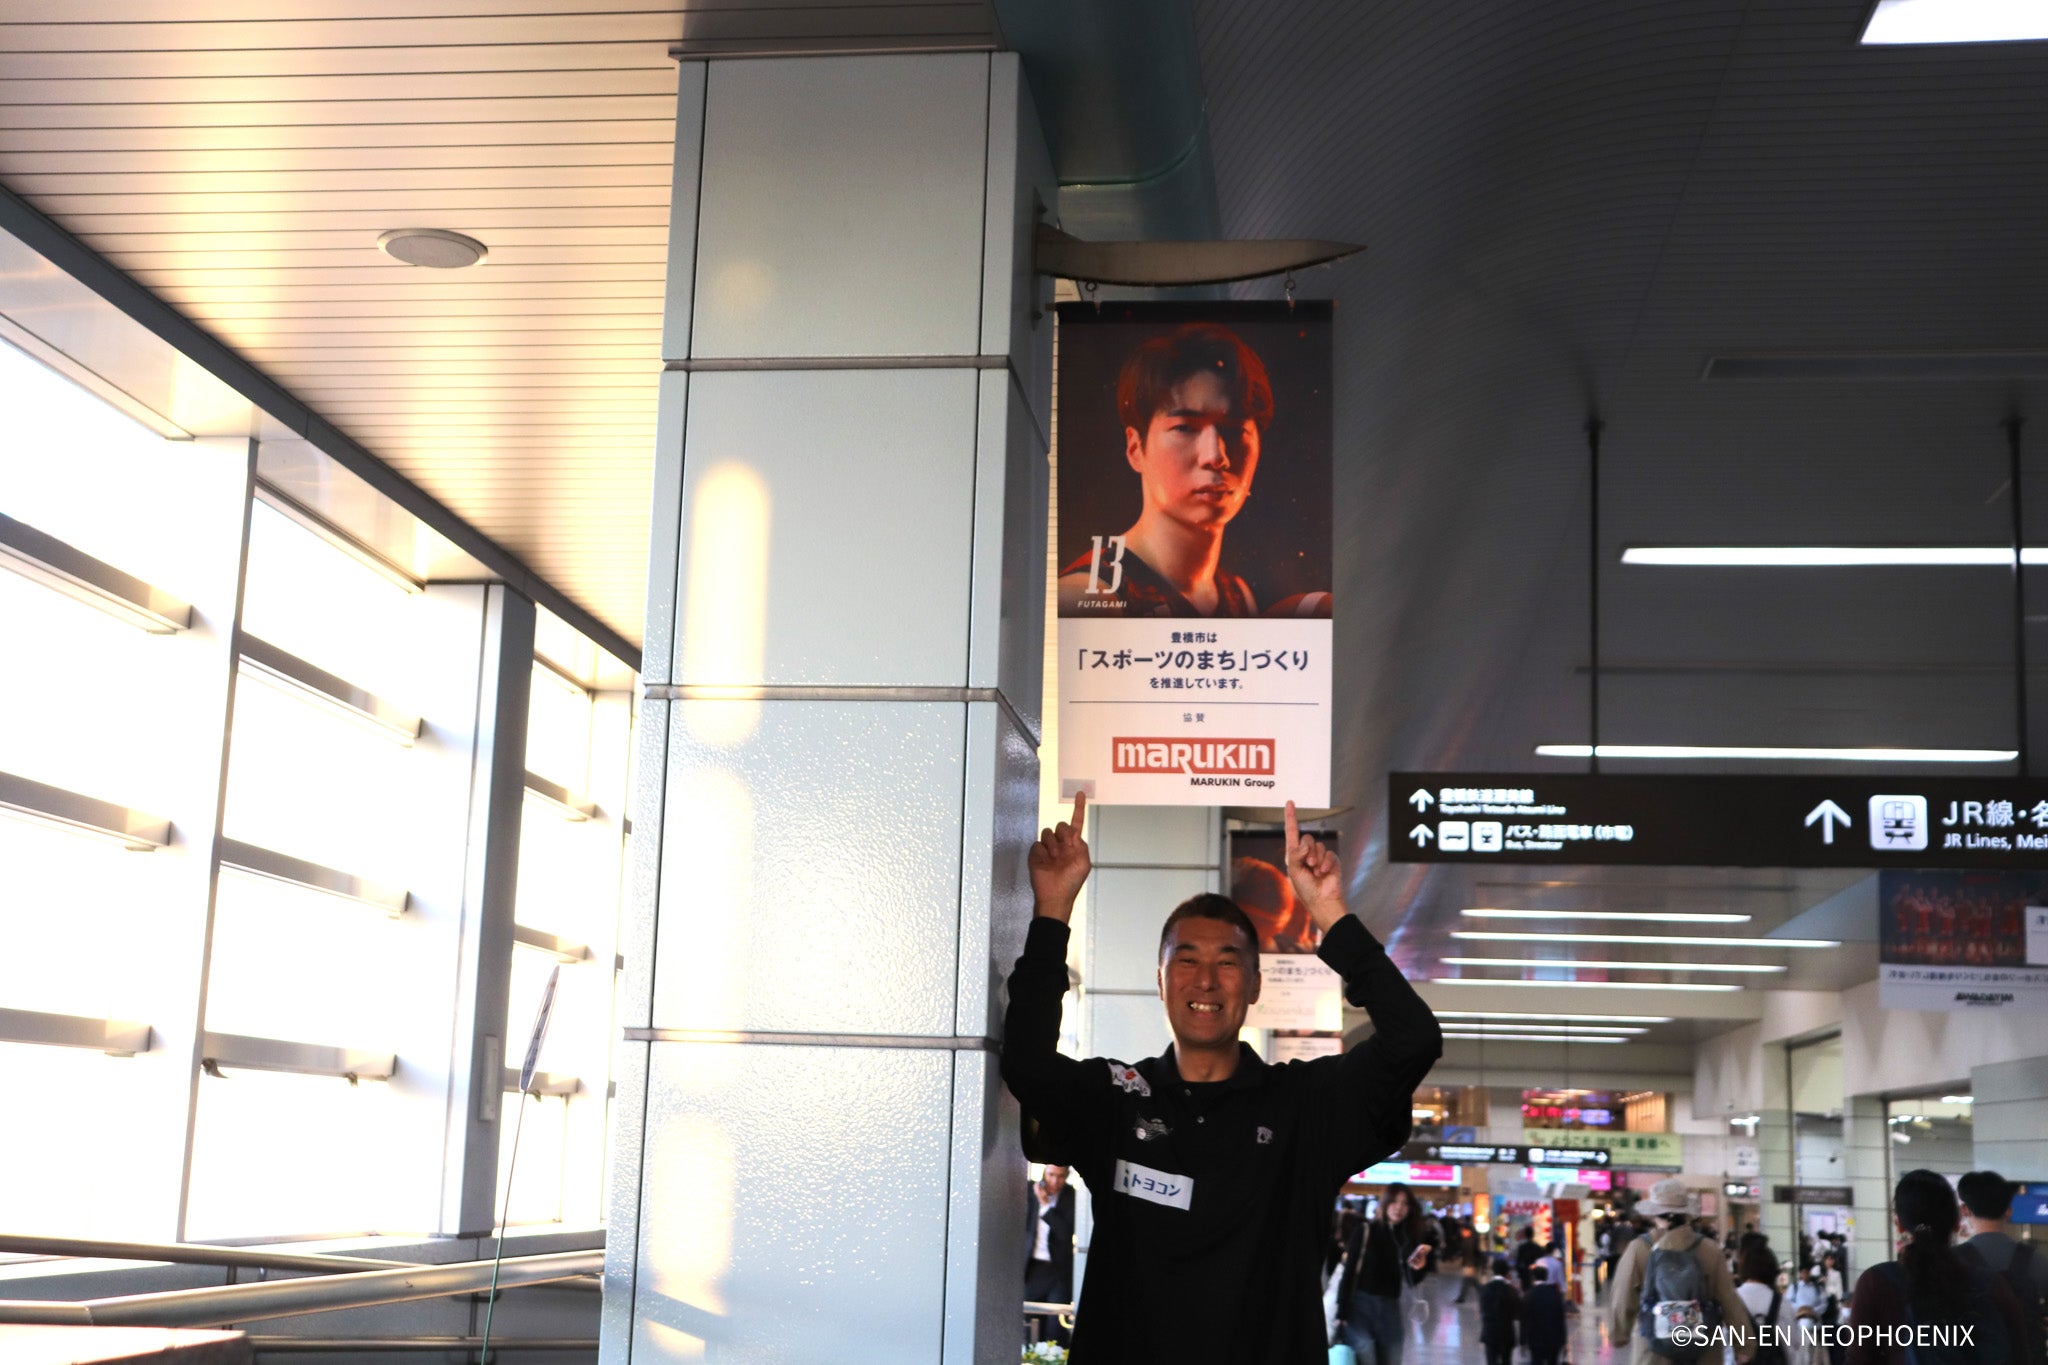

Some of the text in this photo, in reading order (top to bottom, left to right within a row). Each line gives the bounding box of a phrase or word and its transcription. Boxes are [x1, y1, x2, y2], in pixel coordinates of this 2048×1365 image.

[1085, 535, 1126, 594] 13
[1077, 600, 1127, 608] FUTAGAMI
[1171, 631, 1218, 644] 豊橋市は
[1078, 648, 1309, 672] 「スポーツのまち」づくり
[1149, 677, 1243, 690] を推進しています。
[1190, 777, 1275, 789] MARUKIN Group
[1943, 832, 1962, 849] JR
[1966, 832, 2012, 851] Lines,
[1131, 1173, 1181, 1197] トヨコン
